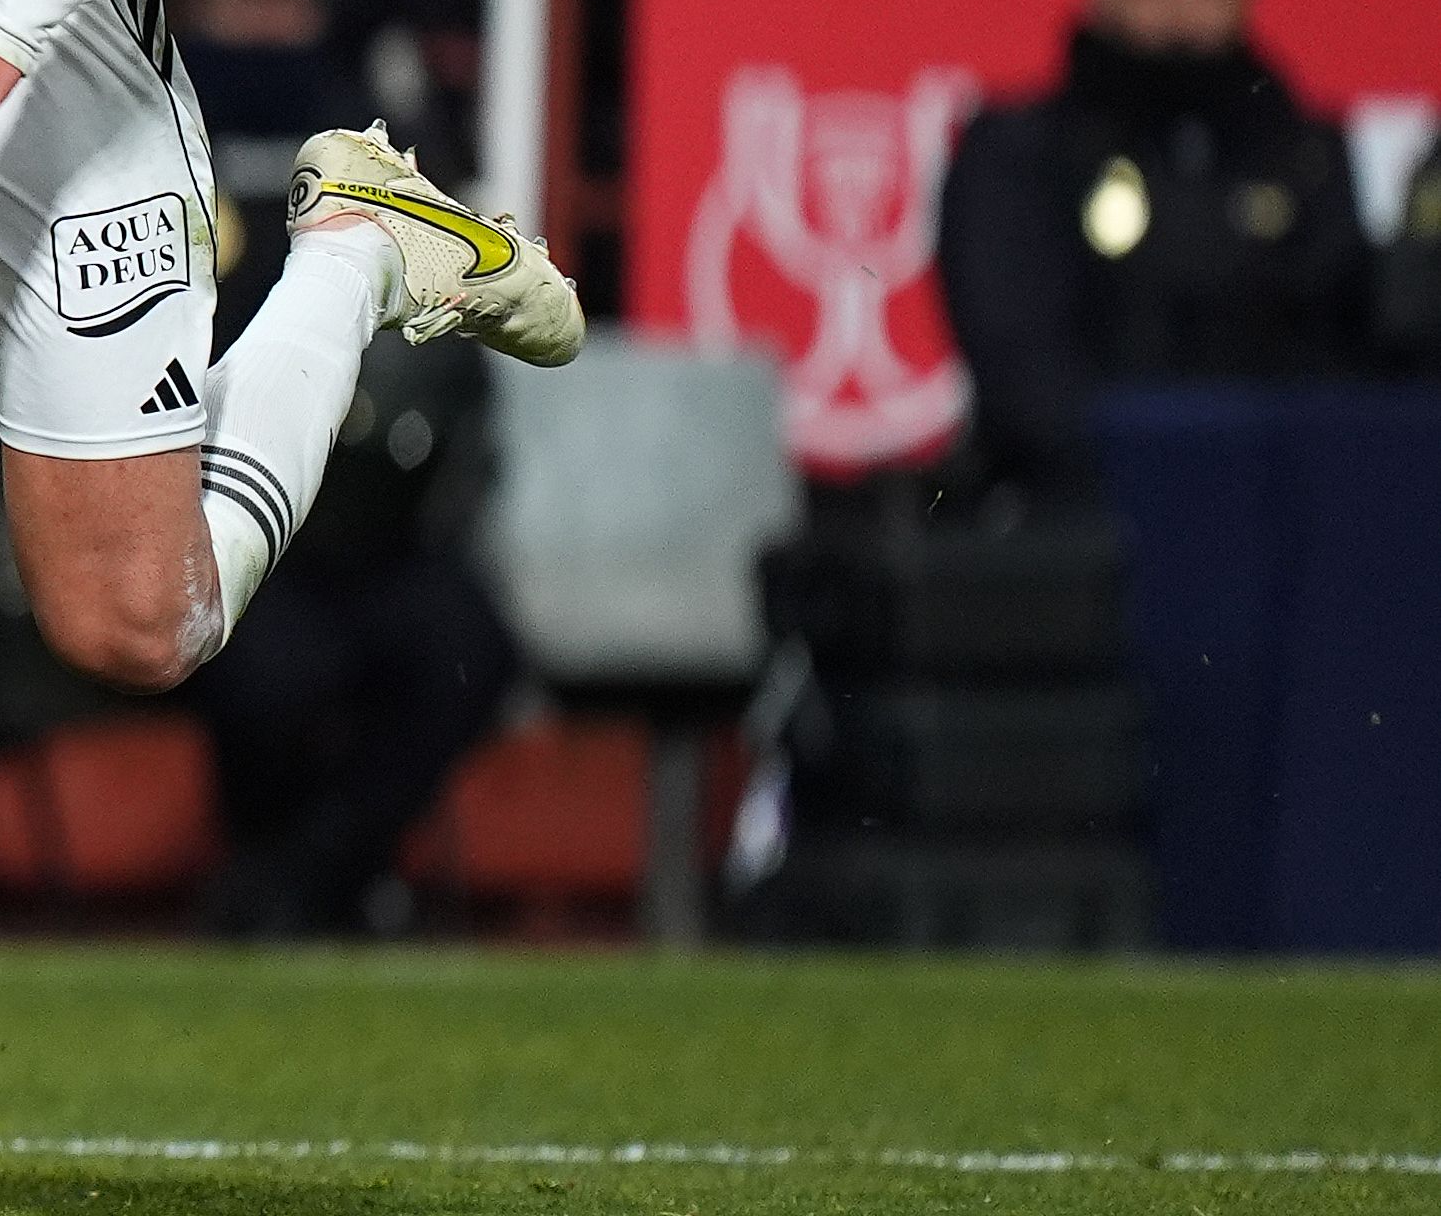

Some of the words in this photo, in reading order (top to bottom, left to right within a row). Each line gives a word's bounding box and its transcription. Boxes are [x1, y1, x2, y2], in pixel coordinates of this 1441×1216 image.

[338, 182, 392, 201] TIEMPO
[69, 207, 176, 256] AQUA
[77, 243, 176, 290] DEUS
